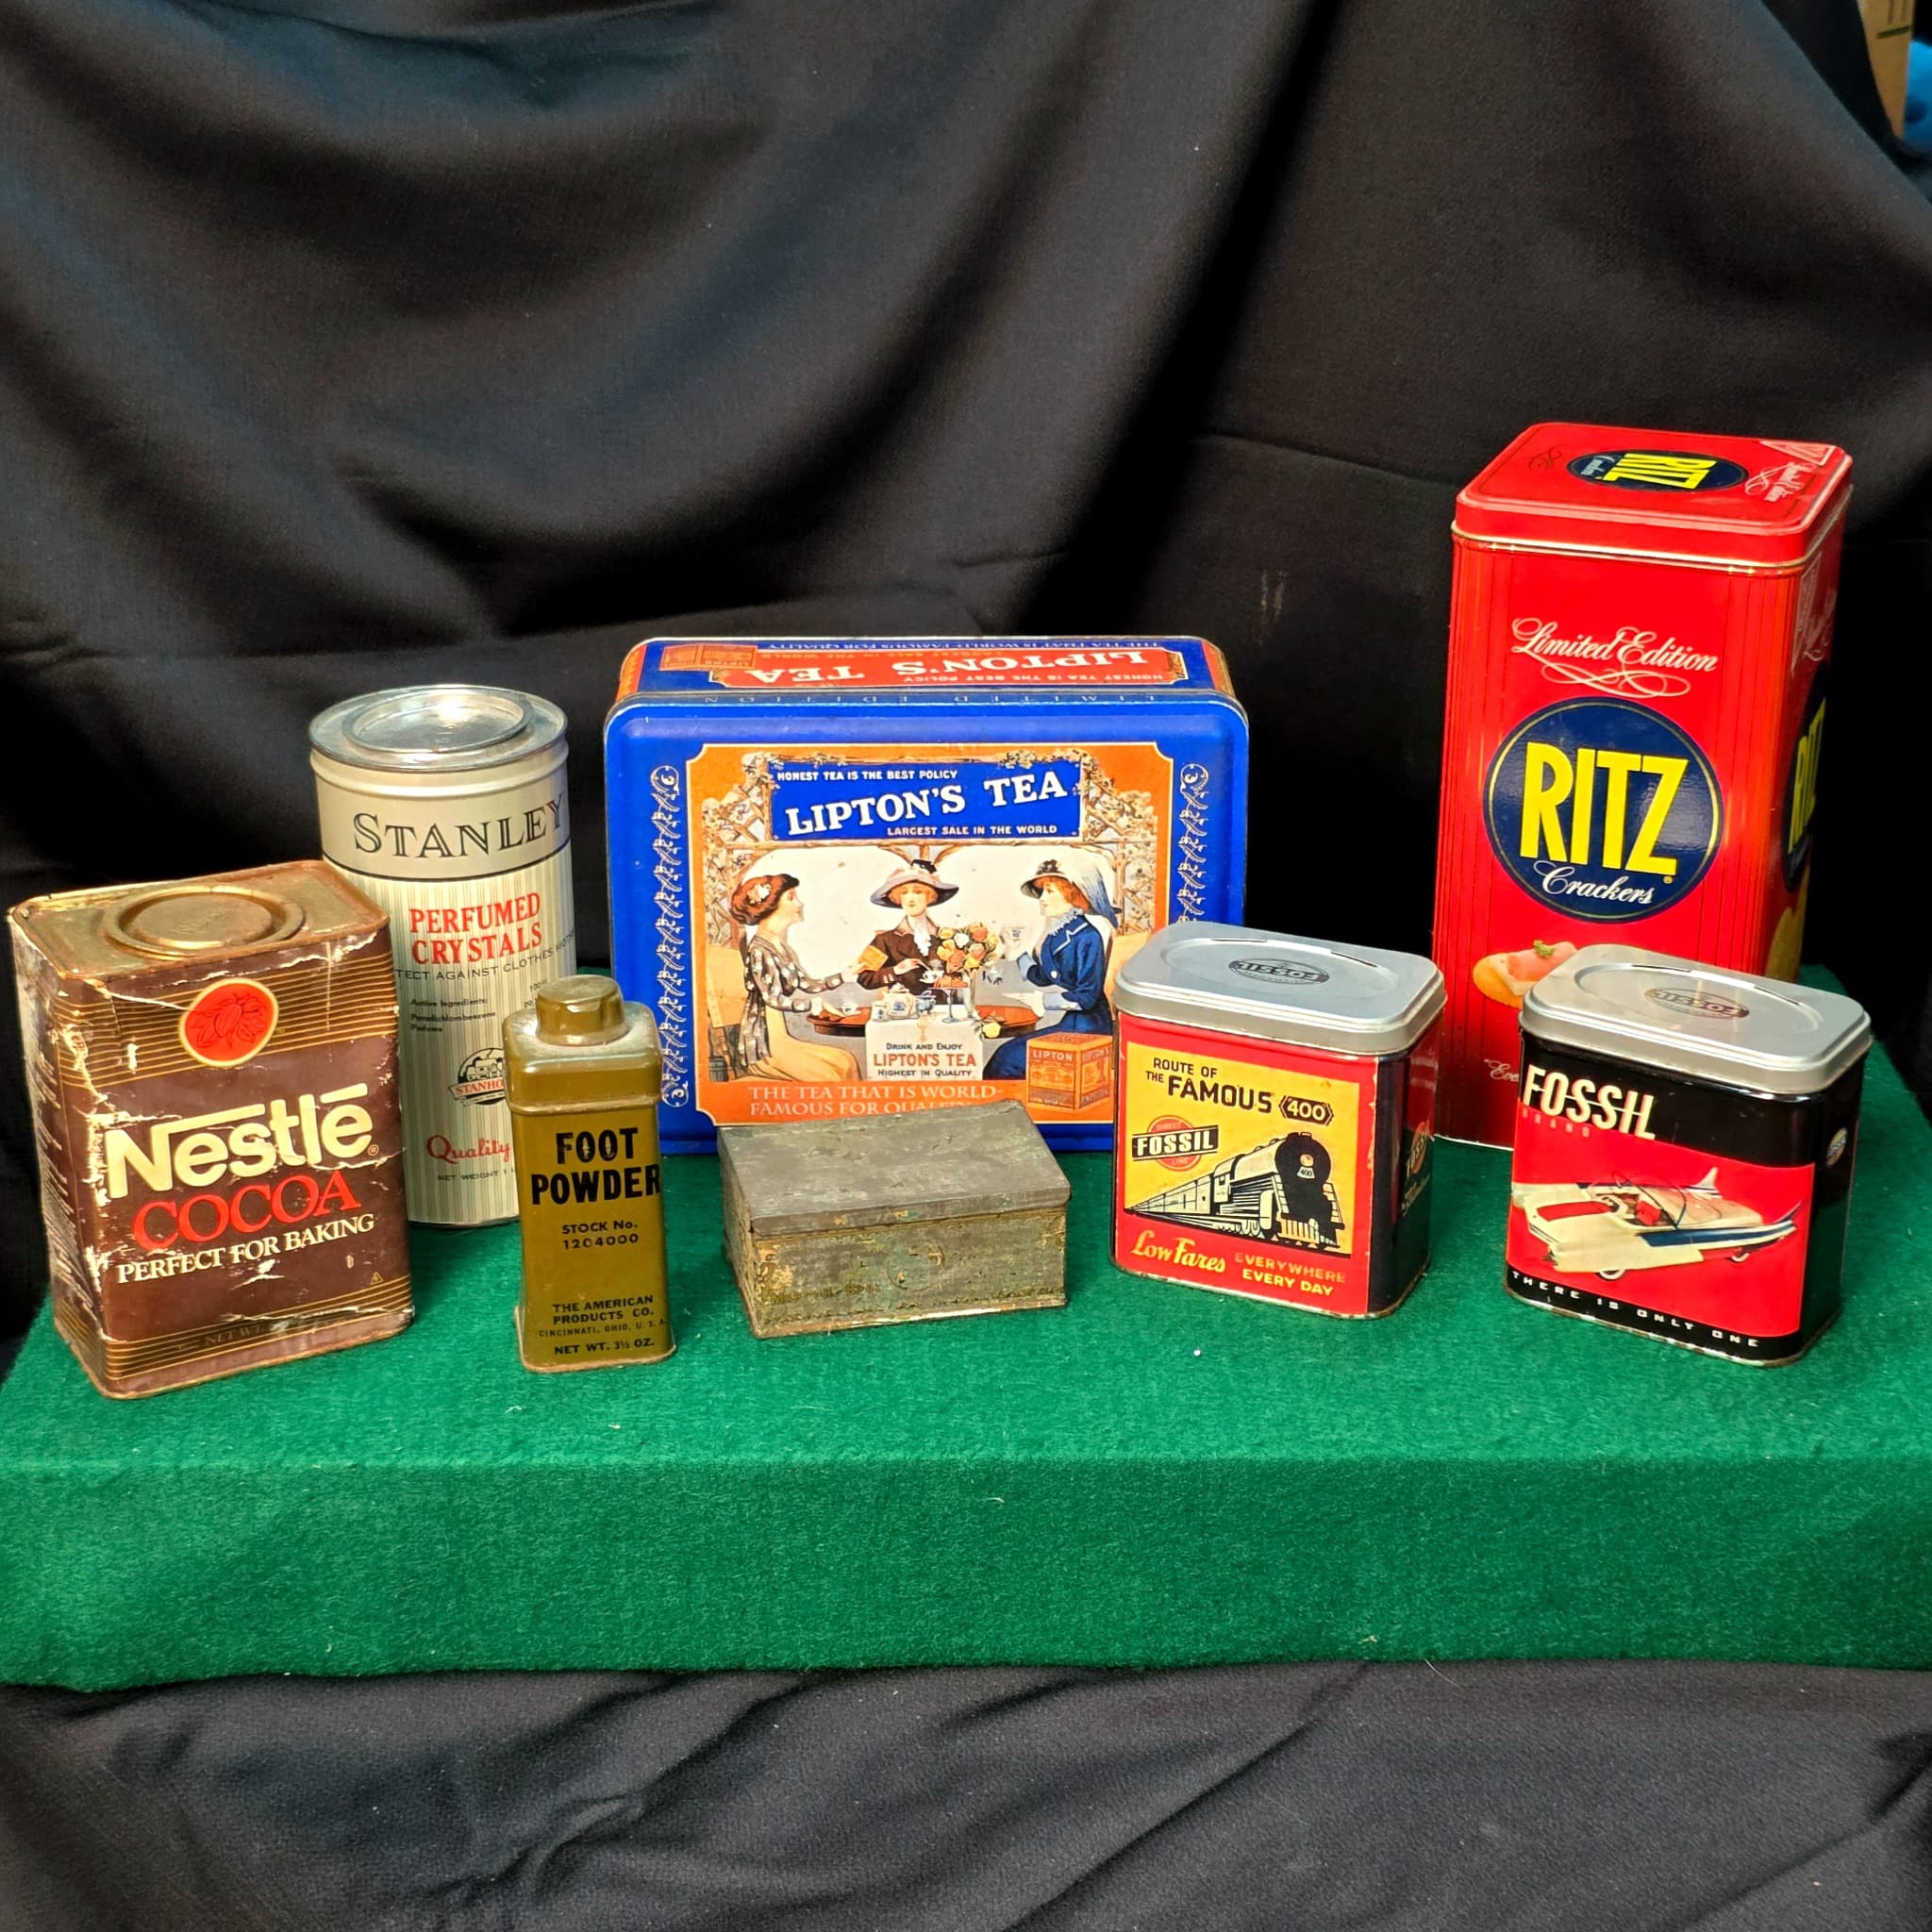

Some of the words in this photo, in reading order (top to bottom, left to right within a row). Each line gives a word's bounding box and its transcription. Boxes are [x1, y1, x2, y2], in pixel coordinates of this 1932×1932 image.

[1603, 453, 1717, 490] RITZ
[1511, 617, 1619, 662] Limited
[1614, 626, 1719, 674] Edition
[743, 665, 865, 683] TEA
[891, 651, 1147, 675] LIPTON'S
[777, 770, 819, 782] HONEST
[824, 770, 845, 781] TEA
[847, 770, 858, 781] IS
[861, 770, 883, 781] THE
[887, 770, 915, 781] BEST
[919, 769, 958, 781] POLICY
[785, 784, 967, 836] LIPTON'S
[983, 770, 1068, 808] TEA
[1520, 741, 1690, 876] RITZ
[353, 792, 564, 858] STANLEY
[887, 825, 937, 837] LARGEST
[941, 825, 970, 836] SALE
[973, 825, 985, 836] IN
[990, 825, 1012, 836] THE
[1016, 824, 1058, 836] WORLD
[1533, 860, 1656, 905] Crackers
[409, 891, 541, 934] PERFUMED
[411, 922, 543, 965] CRYSTALS
[394, 968, 430, 980] TECT
[436, 965, 499, 980] AGAINST
[503, 949, 554, 973] CLOTHES
[1238, 962, 1320, 982] FOSSIL
[874, 1053, 940, 1067] LIPTON'S
[946, 1053, 977, 1067] TEA
[886, 1041, 912, 1051] DRINK
[915, 1042, 934, 1051] AND
[936, 1041, 963, 1052] ENJOY
[1032, 1049, 1074, 1062] LIPTON
[877, 1069, 916, 1077] HIGHEST
[920, 1069, 931, 1077] IN
[935, 1069, 974, 1077] QUALITY
[1153, 1057, 1194, 1075] ROUTE
[1200, 1066, 1218, 1079] OF
[456, 1079, 506, 1096] STANHO
[749, 1086, 790, 1100] THE
[795, 1086, 832, 1100] TEA
[836, 1086, 891, 1099] THAT
[899, 1086, 916, 1098] IS
[1145, 1071, 1164, 1083] THE
[1167, 1075, 1273, 1114] FAMOUS
[749, 1101, 834, 1116] FAMOUS
[839, 1101, 878, 1116] FOR
[1523, 1064, 1657, 1141] FOSSIL
[1522, 1107, 1591, 1138] BRAND
[426, 1135, 511, 1164] Quality
[556, 1126, 639, 1165] FOOT
[1137, 1130, 1214, 1157] FOSSIL
[460, 1170, 499, 1181] WEIGHT
[530, 1163, 661, 1206] POWDER
[132, 1170, 362, 1252] COCOA
[561, 1221, 608, 1235] STOCK
[613, 1219, 638, 1230] No.
[563, 1233, 640, 1250] 1204000
[116, 1247, 226, 1284] PERFECT
[231, 1236, 282, 1266] FOR
[283, 1213, 375, 1252] BAKING
[1131, 1229, 1171, 1262] Low
[1170, 1237, 1226, 1274] Fares
[1234, 1252, 1346, 1284] EVERYWHERE
[1242, 1268, 1296, 1289] EVERY
[1300, 1280, 1334, 1297] DAY
[553, 1303, 580, 1314] THE
[584, 1294, 654, 1311] AMERICAN
[553, 1310, 624, 1325] PRODUCTS
[632, 1307, 655, 1318] CO.
[1512, 1270, 1580, 1299] THERE
[1597, 1297, 1620, 1310] IS
[1637, 1308, 1695, 1331] ONLY
[1711, 1329, 1760, 1348] ONE
[554, 1344, 580, 1356] NET
[586, 1341, 610, 1353] WT.
[634, 1338, 656, 1348] OZ.
